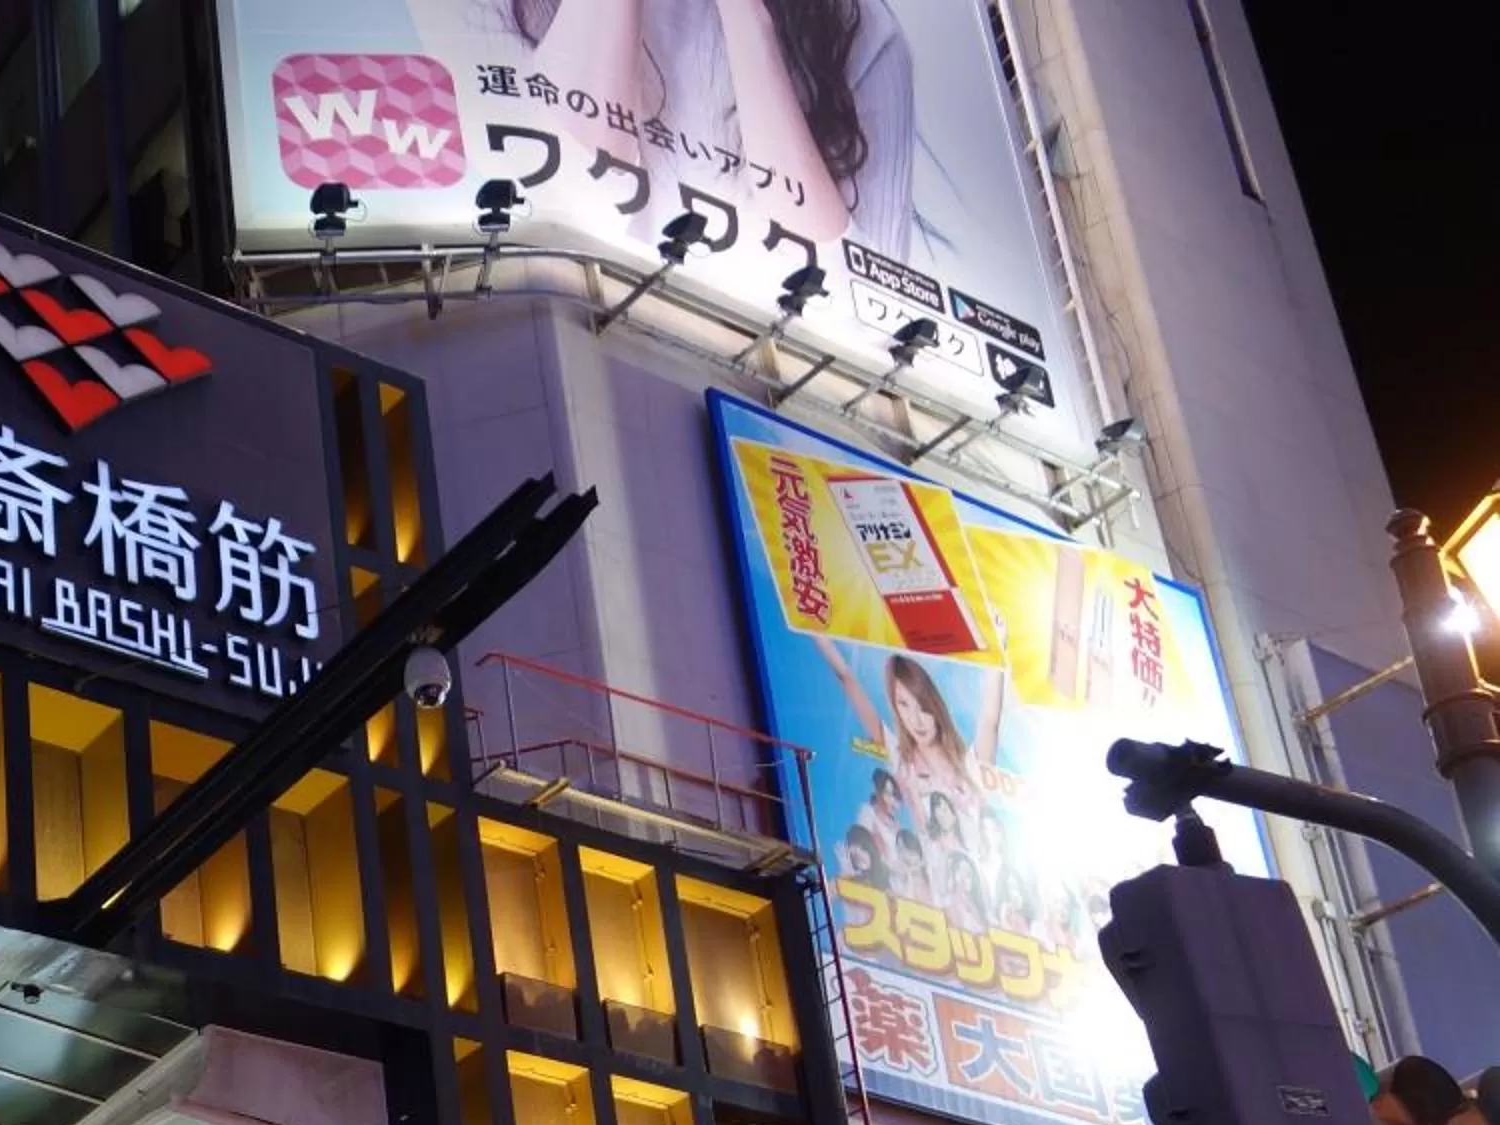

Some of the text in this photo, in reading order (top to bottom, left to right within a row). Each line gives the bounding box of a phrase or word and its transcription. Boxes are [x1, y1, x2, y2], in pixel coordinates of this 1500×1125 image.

[476, 64, 806, 207] 運命の出会いアプリ
[865, 541, 925, 574] EX
[844, 966, 934, 1073] 薬
